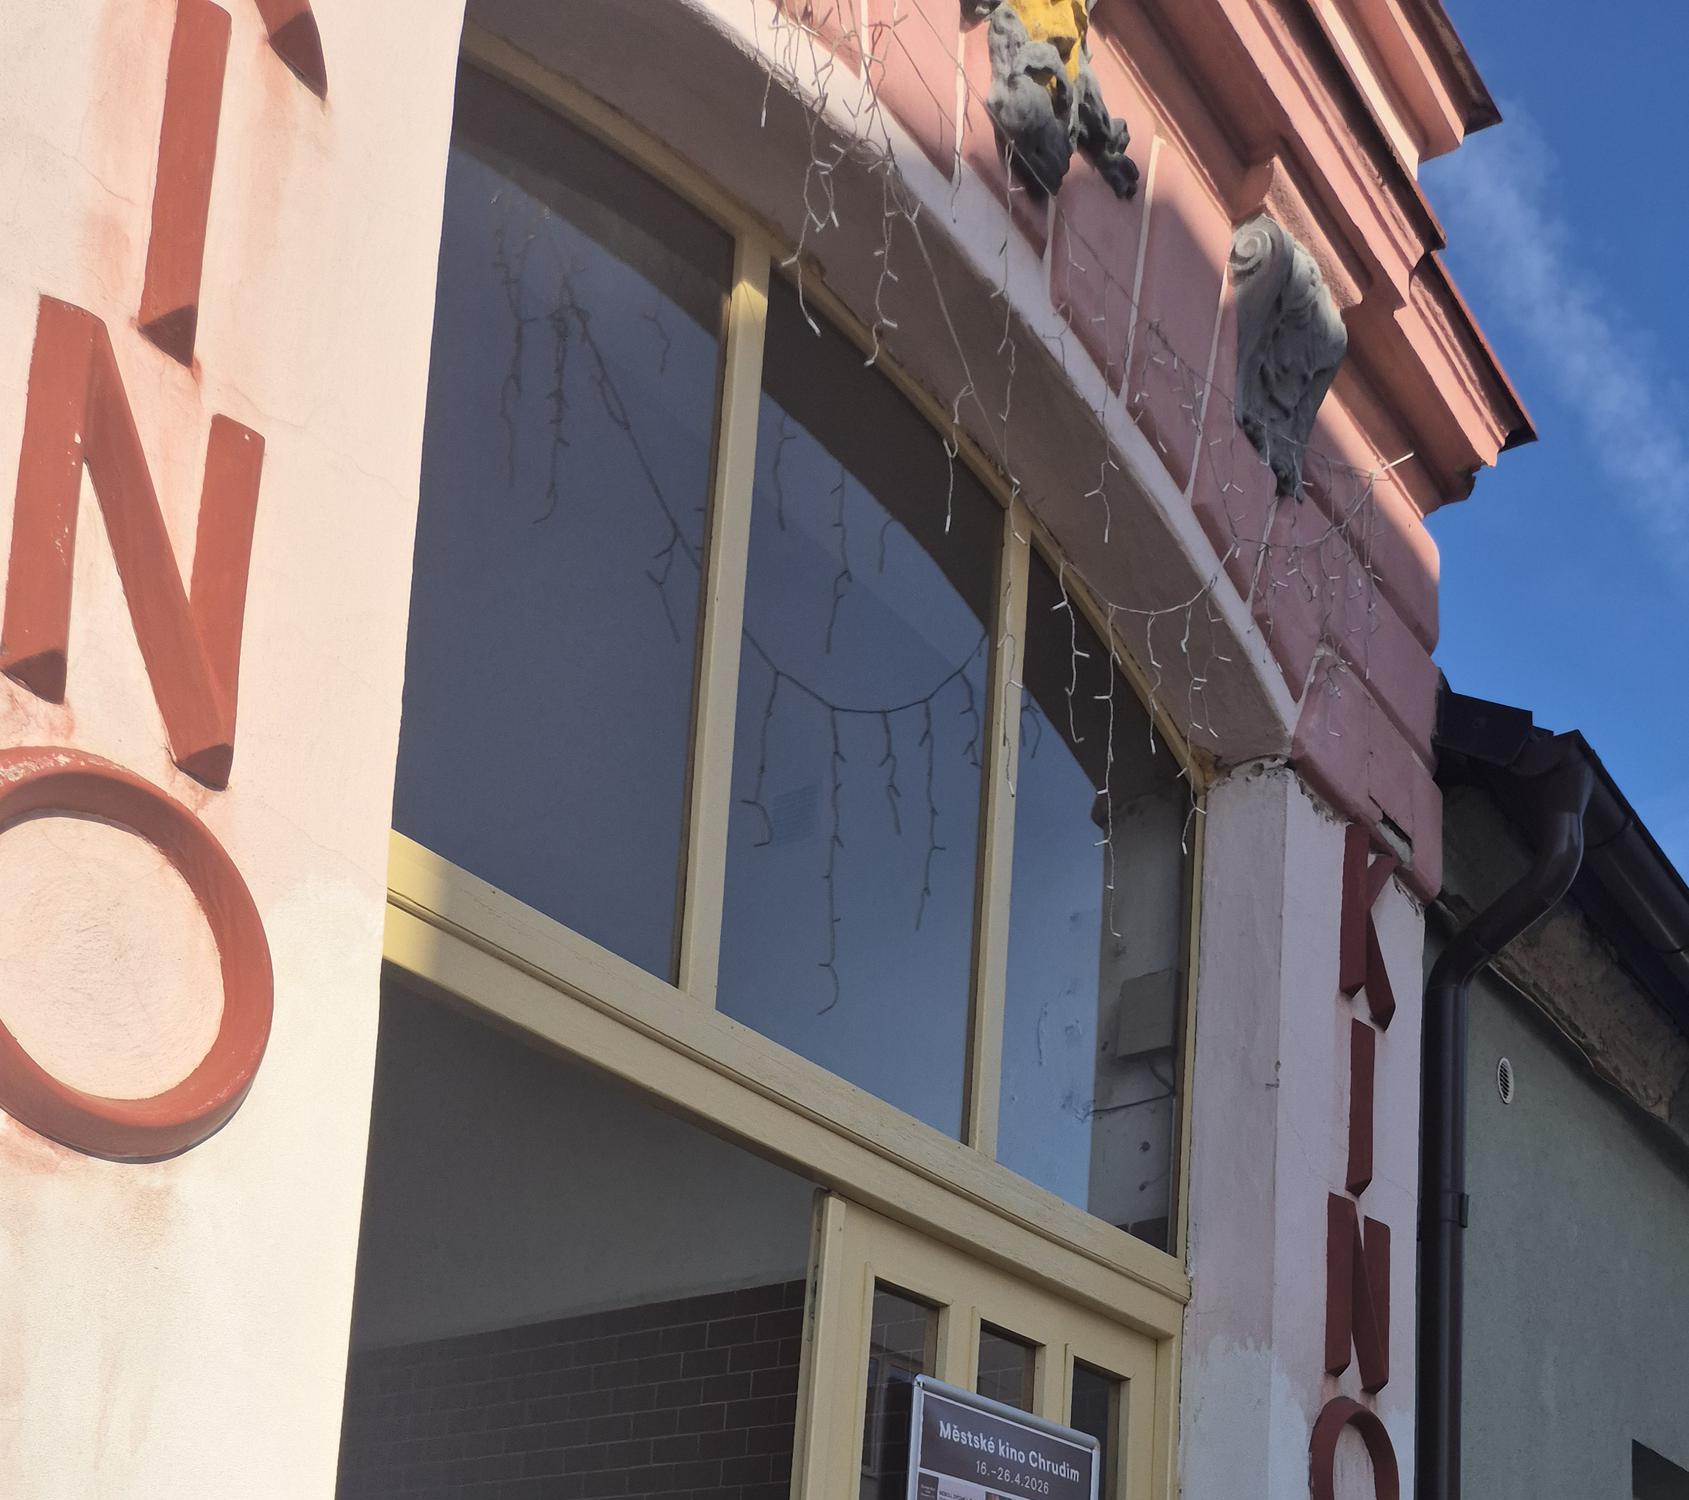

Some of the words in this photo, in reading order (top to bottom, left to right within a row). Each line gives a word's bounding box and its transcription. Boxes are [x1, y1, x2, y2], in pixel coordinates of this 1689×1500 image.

[0, 0, 327, 1164] INO
[939, 1420, 995, 1454] Městské
[998, 1438, 1026, 1464] kino
[1029, 1450, 1080, 1483] Chrudim
